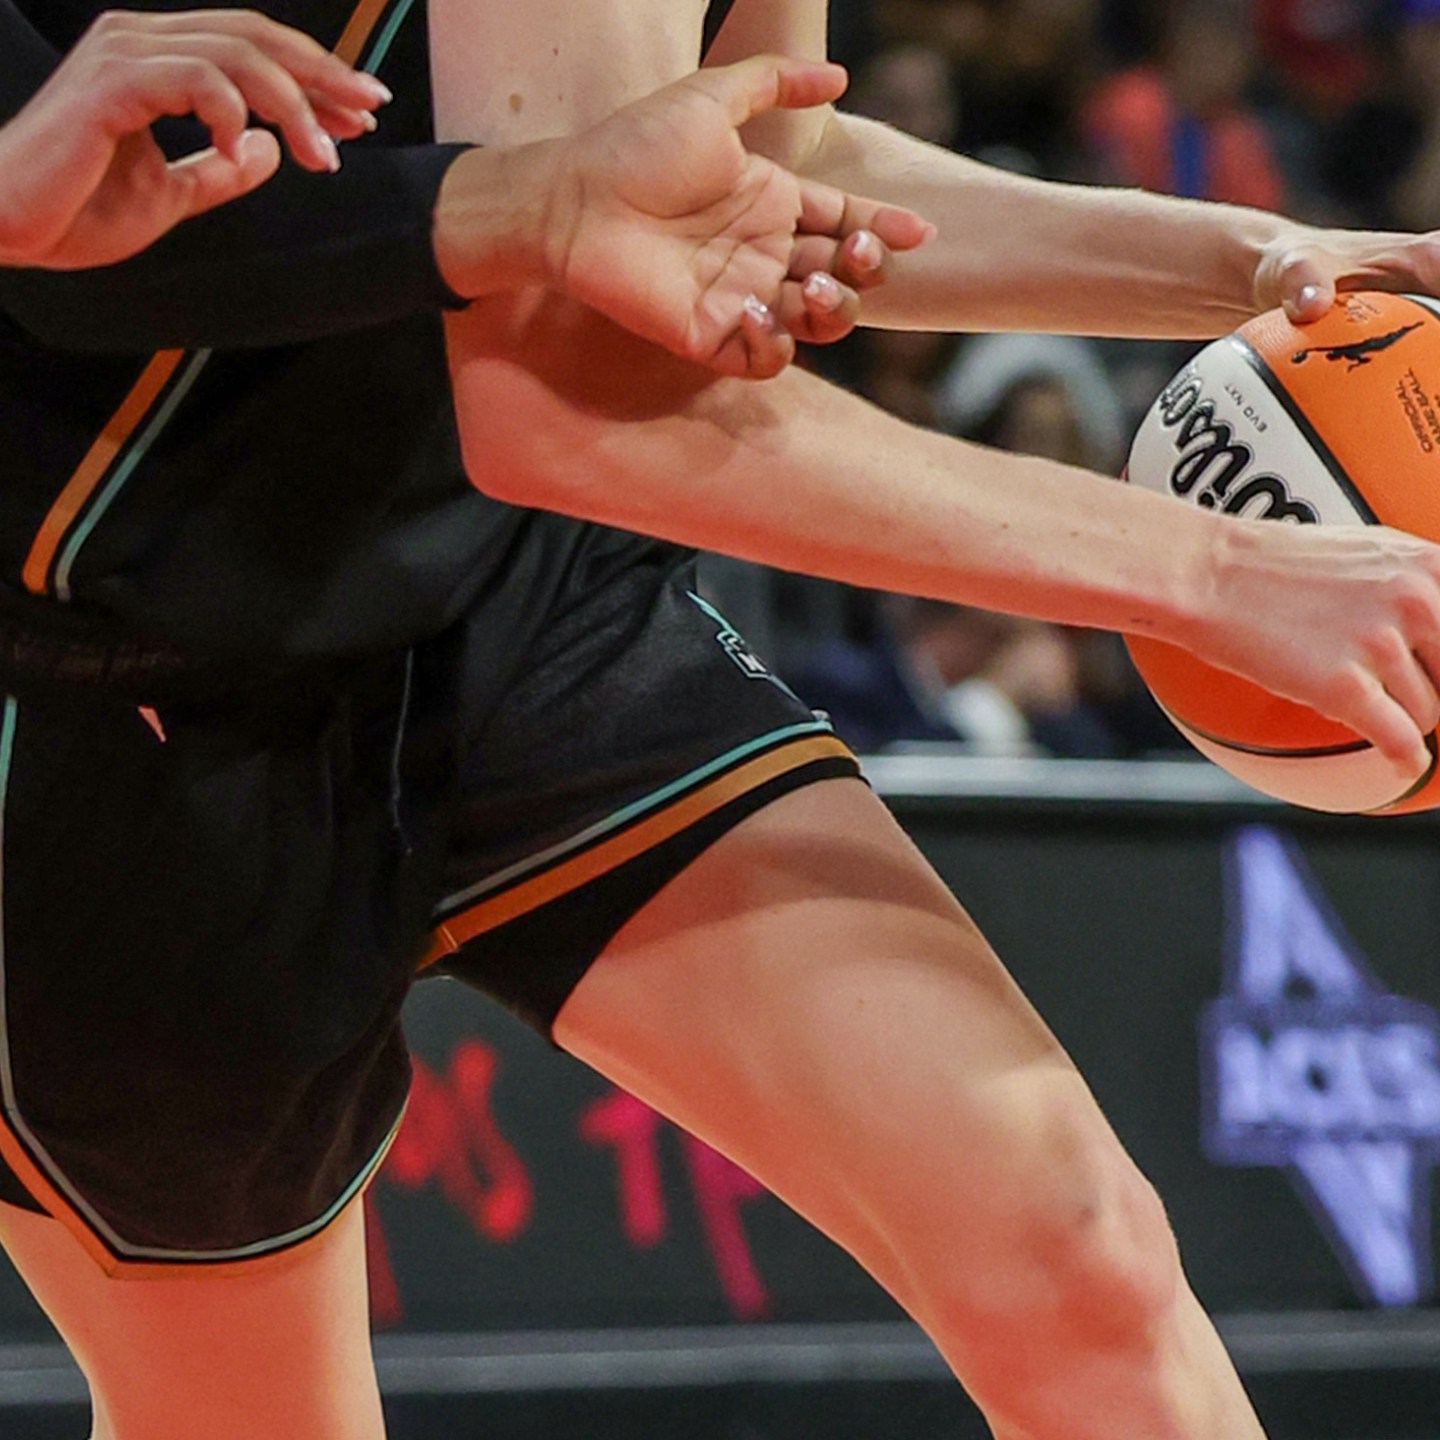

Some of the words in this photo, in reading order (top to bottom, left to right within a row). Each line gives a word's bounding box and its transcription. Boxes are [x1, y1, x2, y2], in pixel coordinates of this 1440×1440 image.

[1224, 384, 1245, 408] NXT
[1404, 367, 1429, 407] BALL
[1242, 406, 1268, 433] EVO
